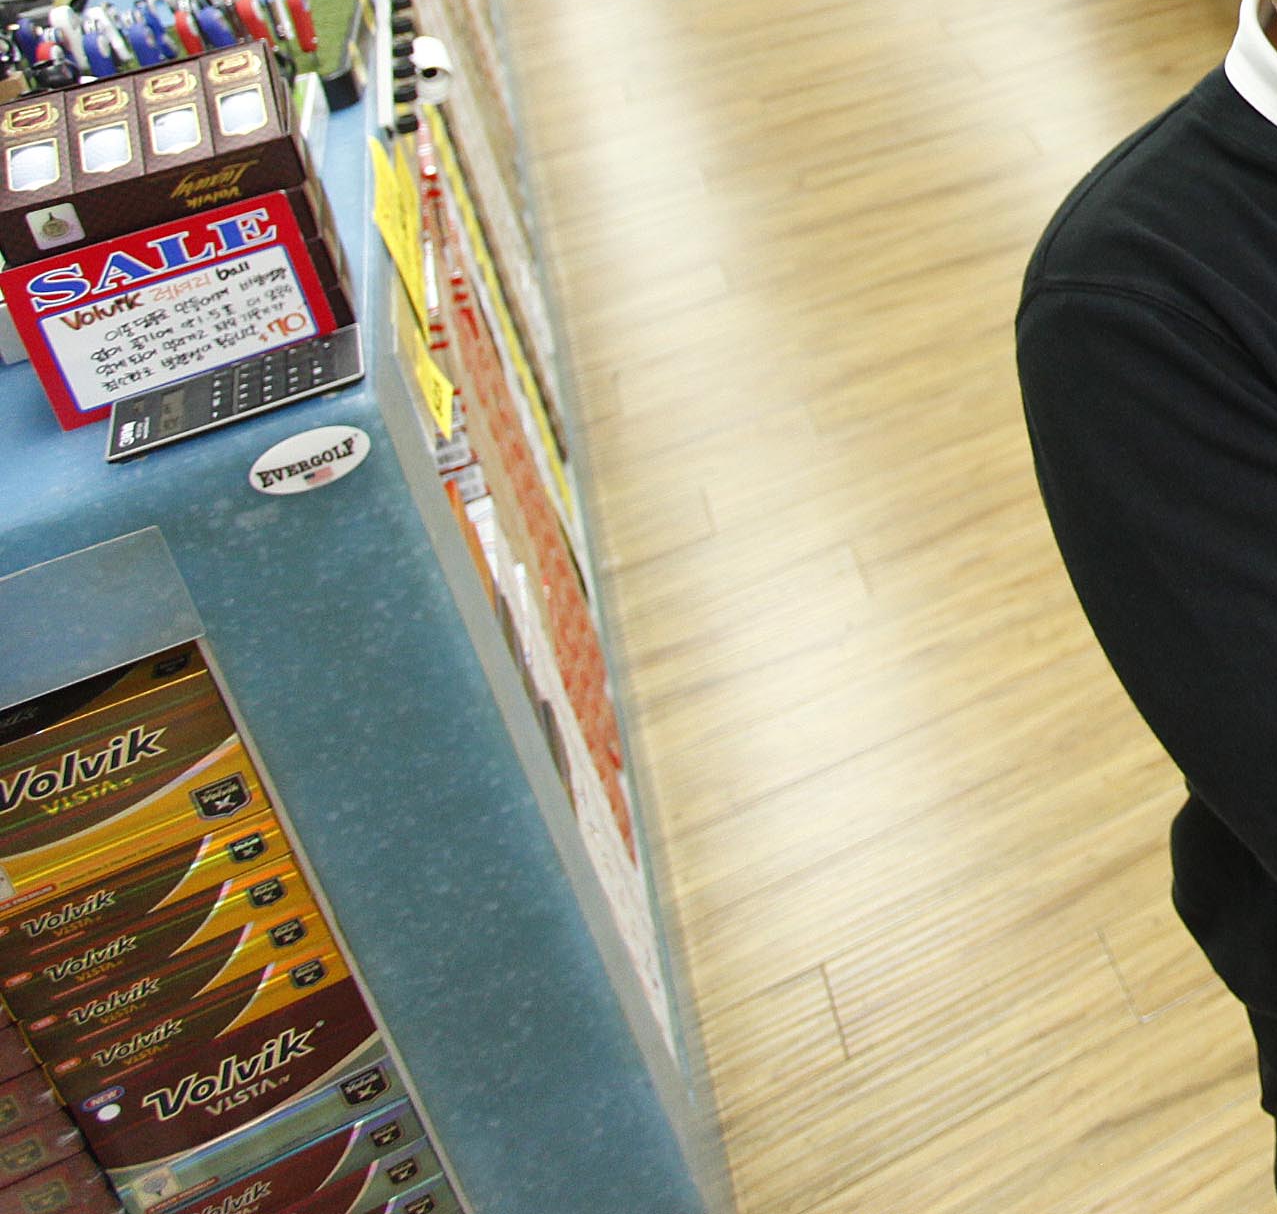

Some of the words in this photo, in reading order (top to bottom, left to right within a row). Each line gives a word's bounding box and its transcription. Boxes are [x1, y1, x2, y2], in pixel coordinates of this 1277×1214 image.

[25, 207, 279, 313] SALE
[216, 261, 250, 283] ball
[256, 437, 355, 488] EVERGOLF
[0, 725, 168, 814] Volvik
[20, 888, 116, 938] Volvik
[43, 935, 138, 983] Volvik
[67, 976, 161, 1025] Volvik
[90, 1017, 184, 1067] Volvik
[140, 1027, 316, 1122] Volvik
[205, 1078, 277, 1117] VISTA
